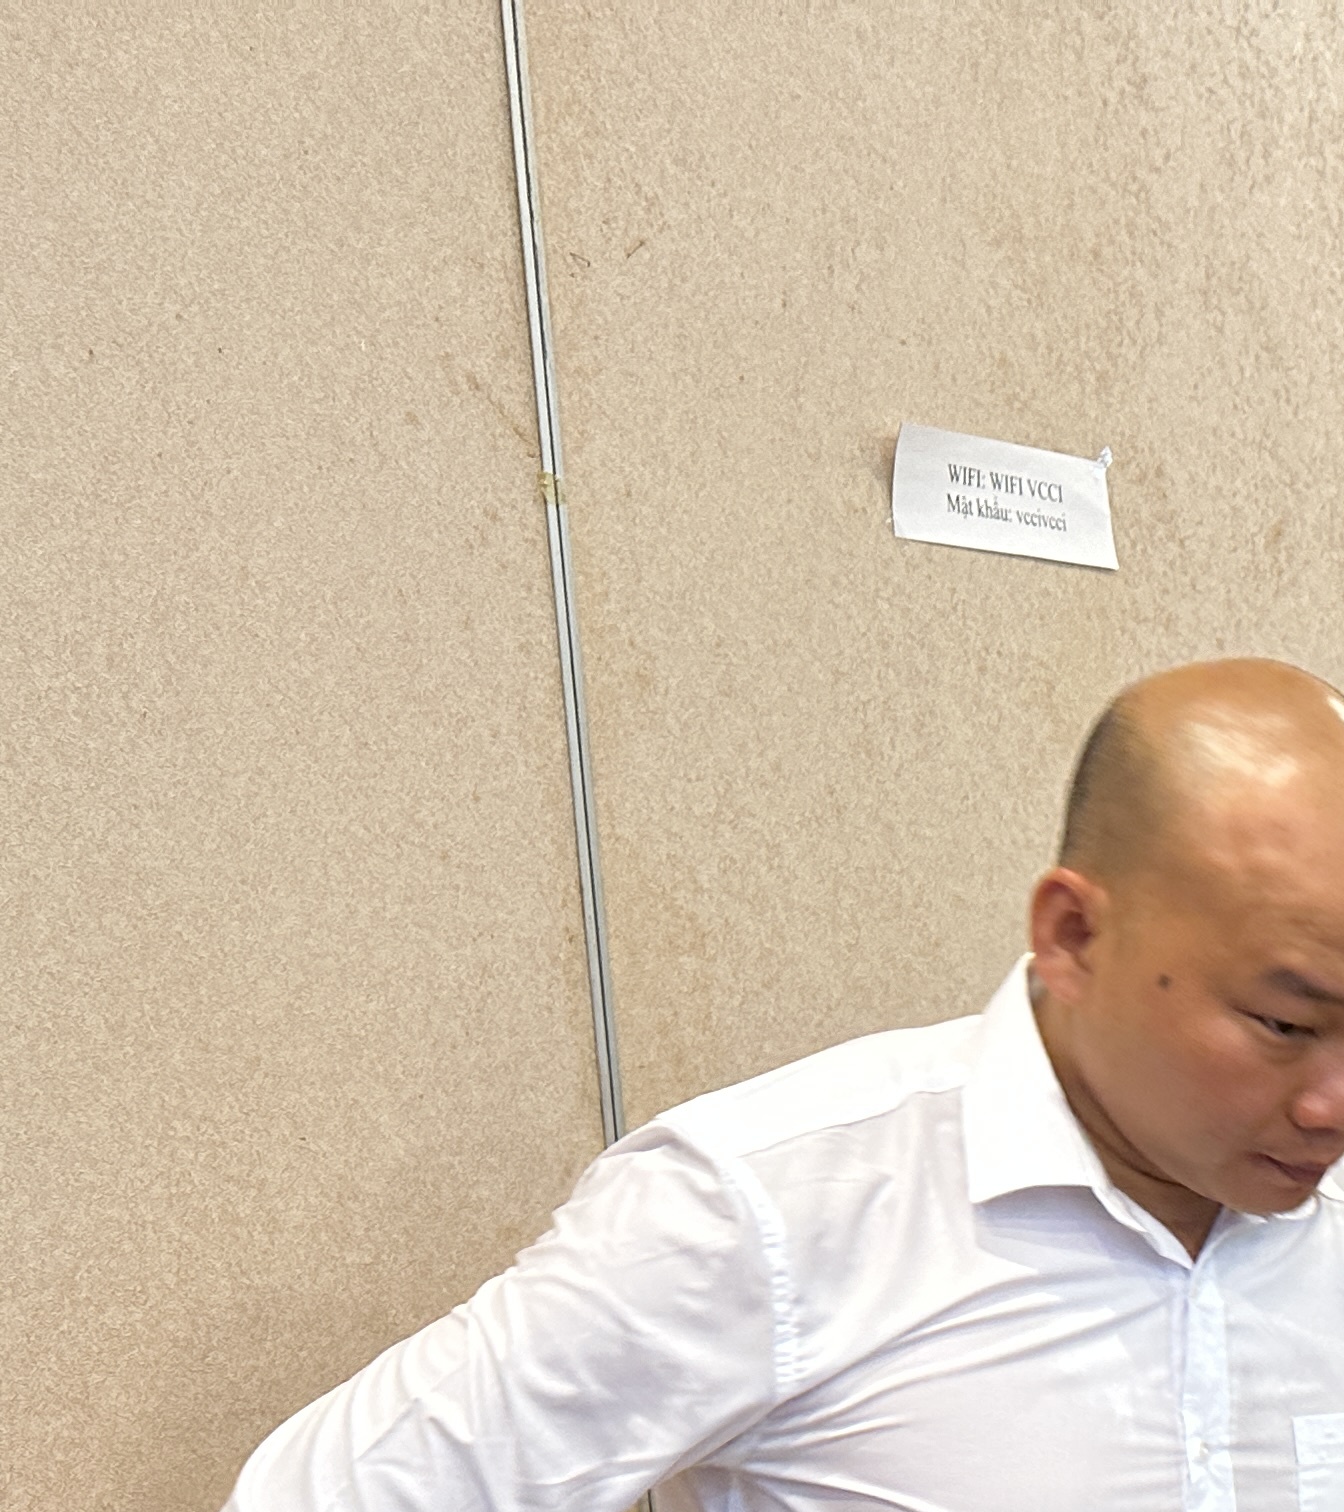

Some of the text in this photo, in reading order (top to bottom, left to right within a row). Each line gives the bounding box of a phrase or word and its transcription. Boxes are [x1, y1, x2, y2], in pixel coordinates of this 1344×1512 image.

[948, 463, 1063, 503] WIFI: WIFI VCCI
[947, 493, 974, 519] Mật
[1015, 508, 1067, 532] vccivcci
